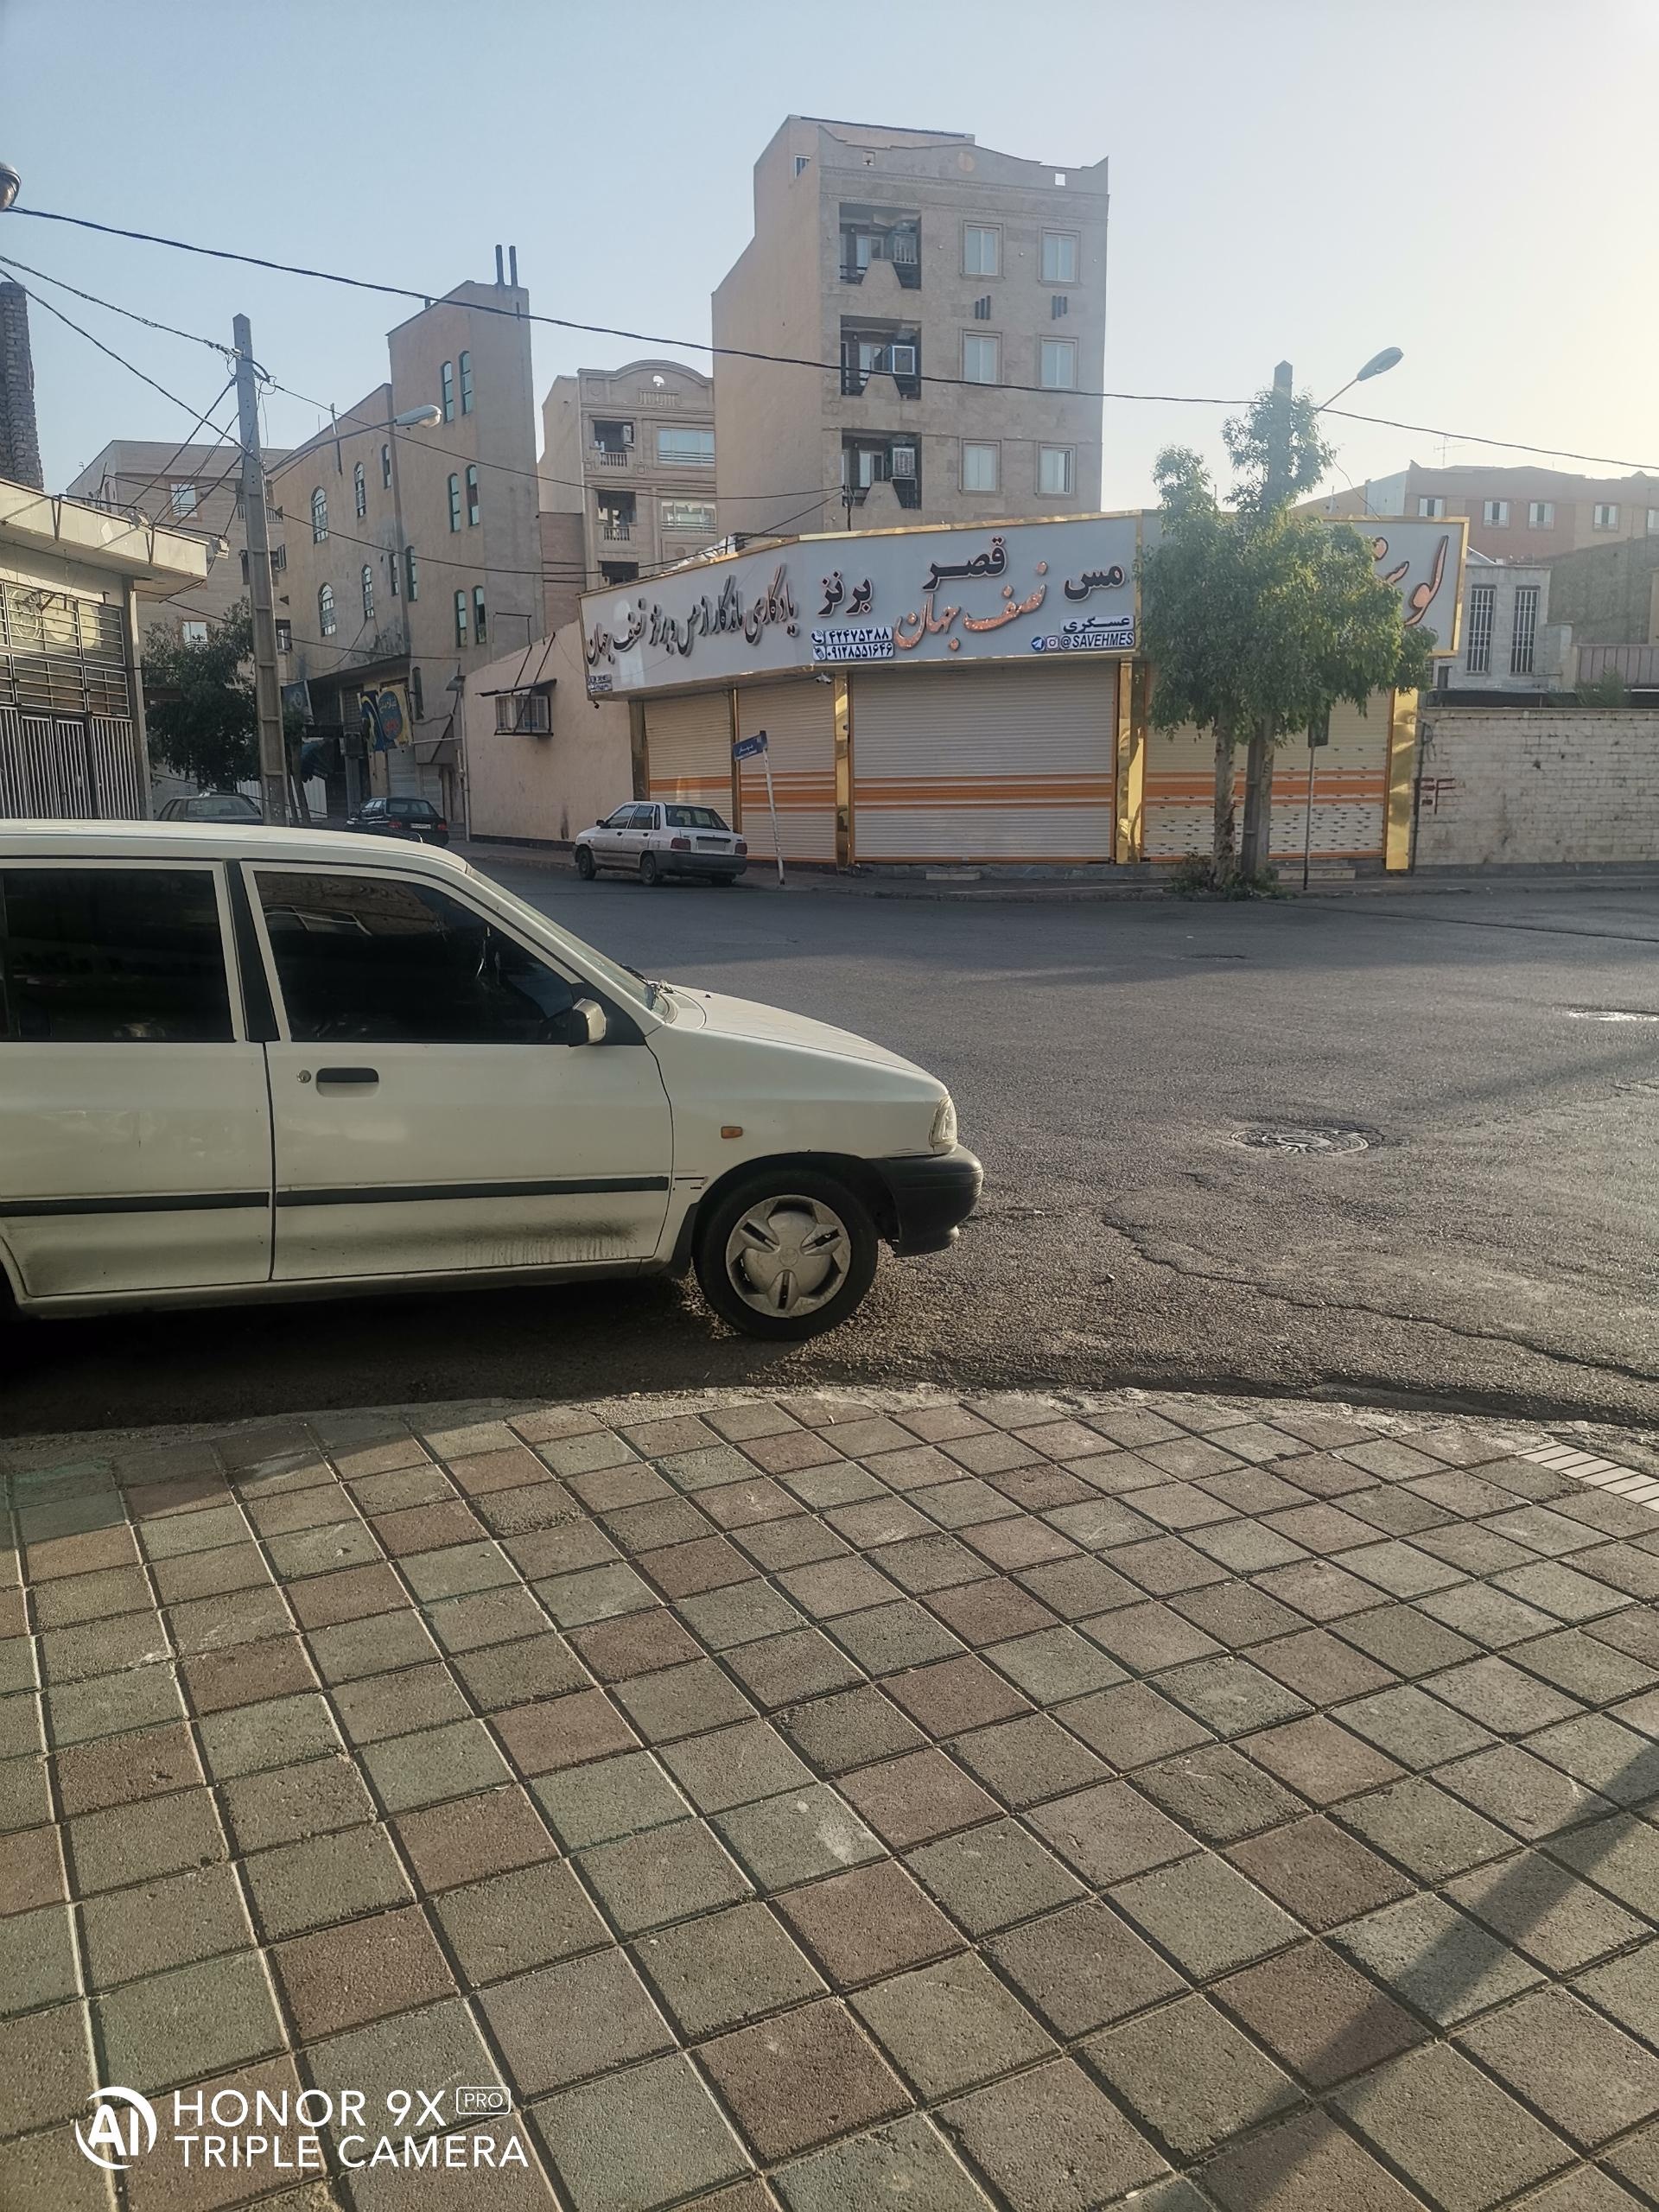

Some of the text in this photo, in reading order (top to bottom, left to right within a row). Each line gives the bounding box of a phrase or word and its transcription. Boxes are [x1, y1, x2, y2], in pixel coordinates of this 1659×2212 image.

[817, 563, 1126, 618] مس برنز
[922, 535, 1007, 592] قصر
[613, 598, 646, 652] نصف
[893, 561, 1047, 652] نصف جهان
[1063, 616, 1130, 632] عسکری
[586, 622, 615, 666] جهان
[1060, 632, 1134, 649] @SAVEHMES
